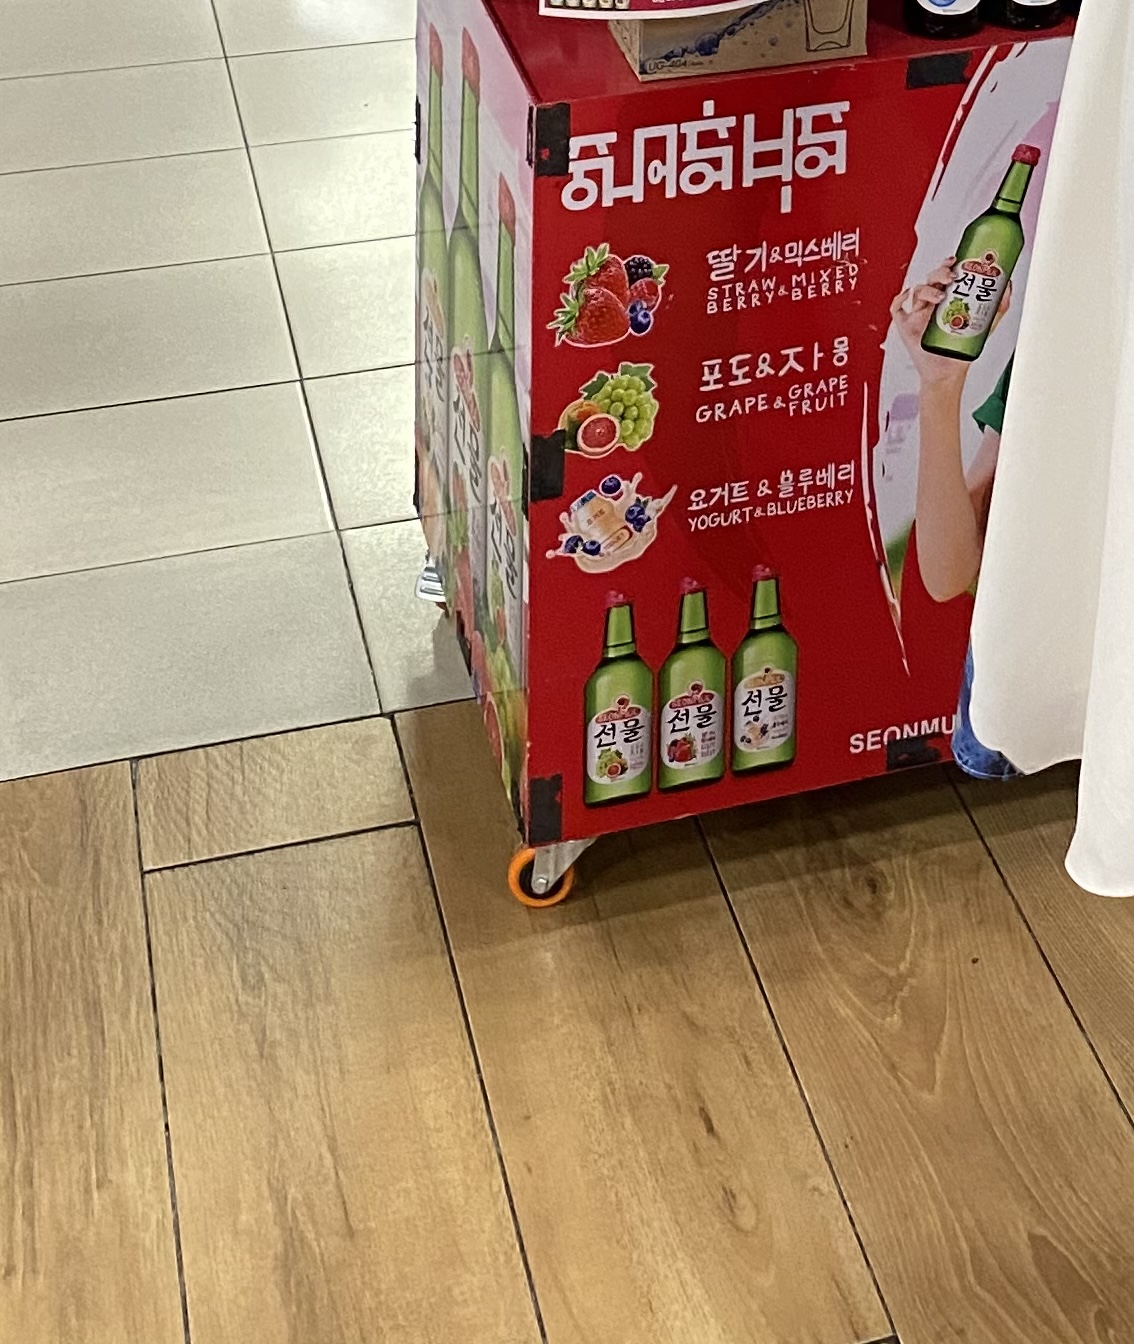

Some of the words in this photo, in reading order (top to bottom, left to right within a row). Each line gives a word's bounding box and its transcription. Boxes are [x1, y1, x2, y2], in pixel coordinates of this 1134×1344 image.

[706, 290, 775, 314] BERRY
[791, 276, 858, 301] BERRY
[707, 275, 776, 301] STRAW
[791, 263, 859, 288] MIXED
[696, 393, 769, 423] GRAPE
[773, 395, 786, 410] &
[788, 374, 849, 400] GRAPE
[788, 390, 849, 417] FRUIT
[687, 480, 750, 511] 요거트
[666, 702, 718, 734] 선물
[741, 684, 789, 719] 선물
[593, 718, 646, 749] 선물
[848, 714, 957, 755] SEONMU
